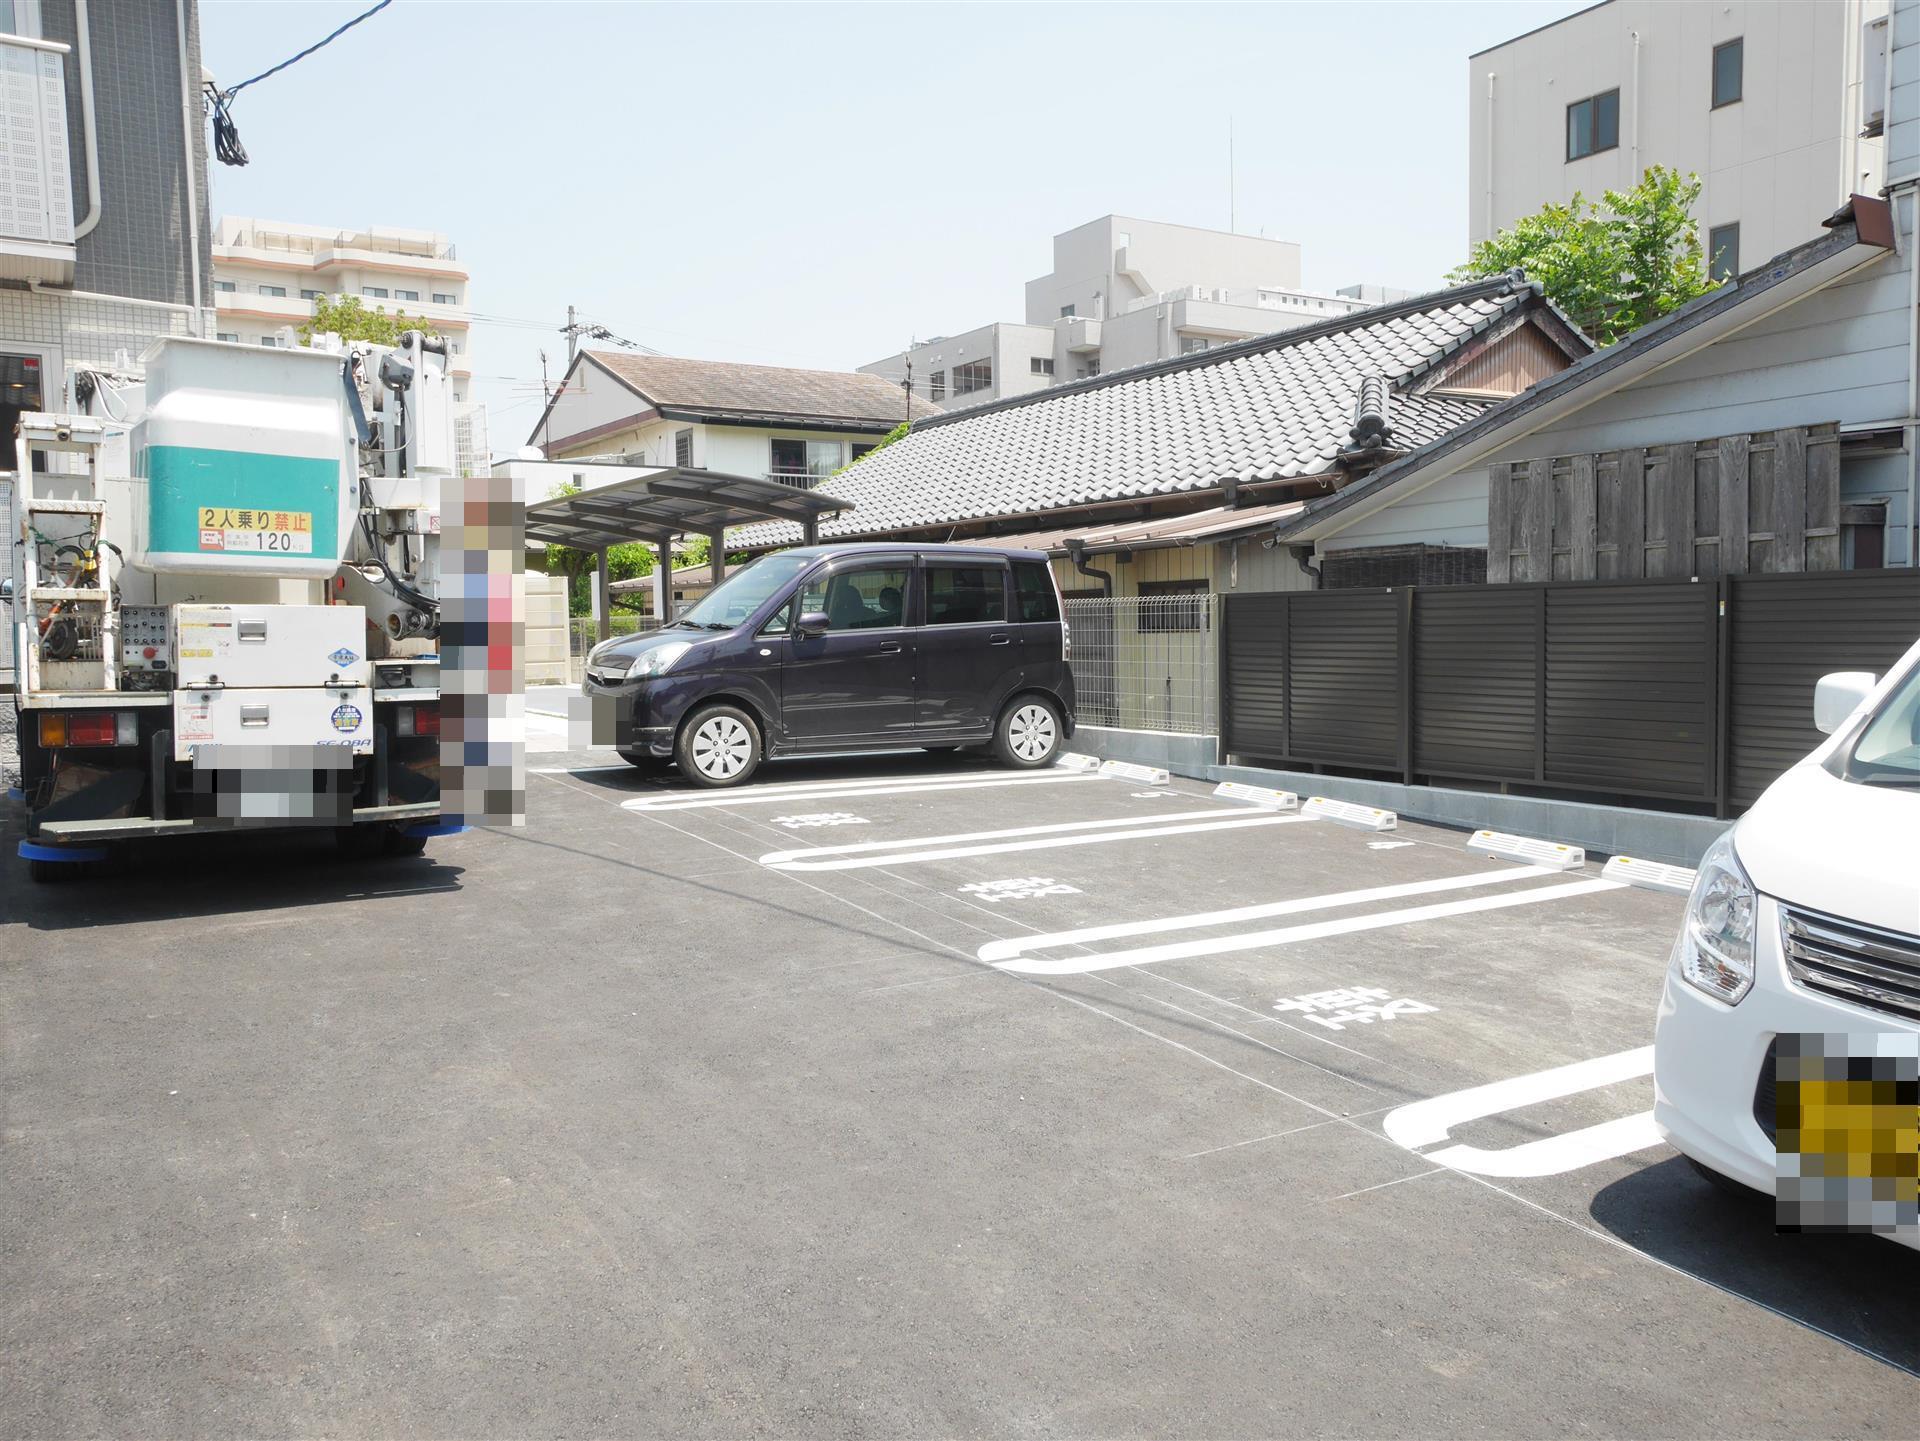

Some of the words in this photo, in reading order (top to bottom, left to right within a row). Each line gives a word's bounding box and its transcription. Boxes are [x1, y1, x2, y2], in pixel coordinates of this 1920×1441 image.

[204, 509, 307, 532] 2人乗り禁止
[256, 532, 291, 551] 120
[769, 811, 872, 830] 軽
[956, 876, 1084, 903] 軽
[1272, 985, 1441, 1031] 軽
